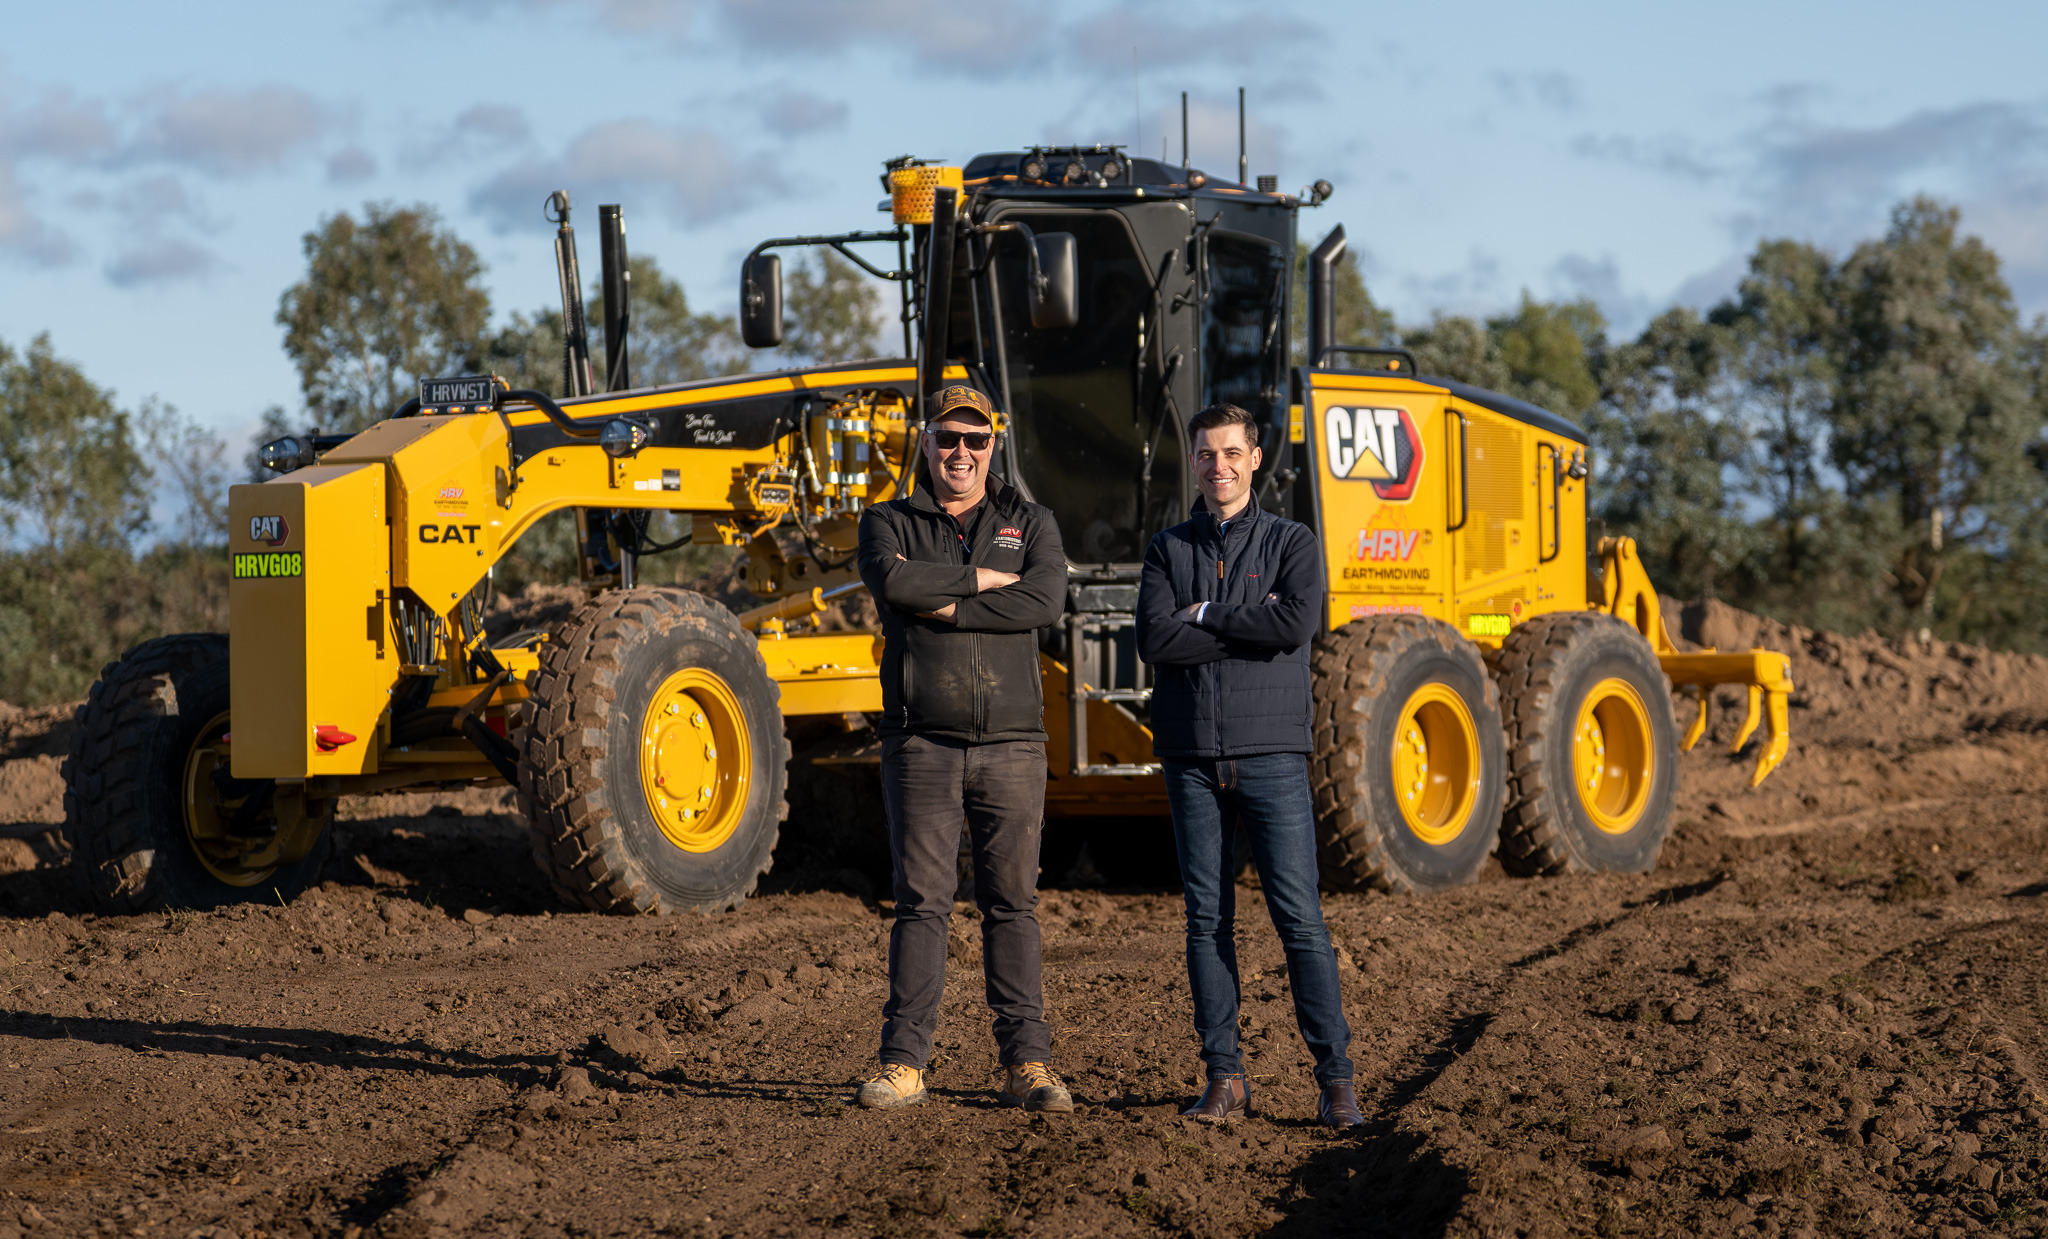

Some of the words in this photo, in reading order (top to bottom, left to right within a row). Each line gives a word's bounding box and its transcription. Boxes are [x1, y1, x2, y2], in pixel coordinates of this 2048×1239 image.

[432, 383, 486, 402] HRVWST
[1326, 406, 1400, 480] CAT
[440, 487, 464, 498] HRV
[250, 516, 280, 540] CAT
[418, 524, 482, 544] CAT
[1357, 529, 1420, 562] HRV
[234, 553, 302, 578] HRVG08
[1343, 567, 1431, 580] EARTHMOVING
